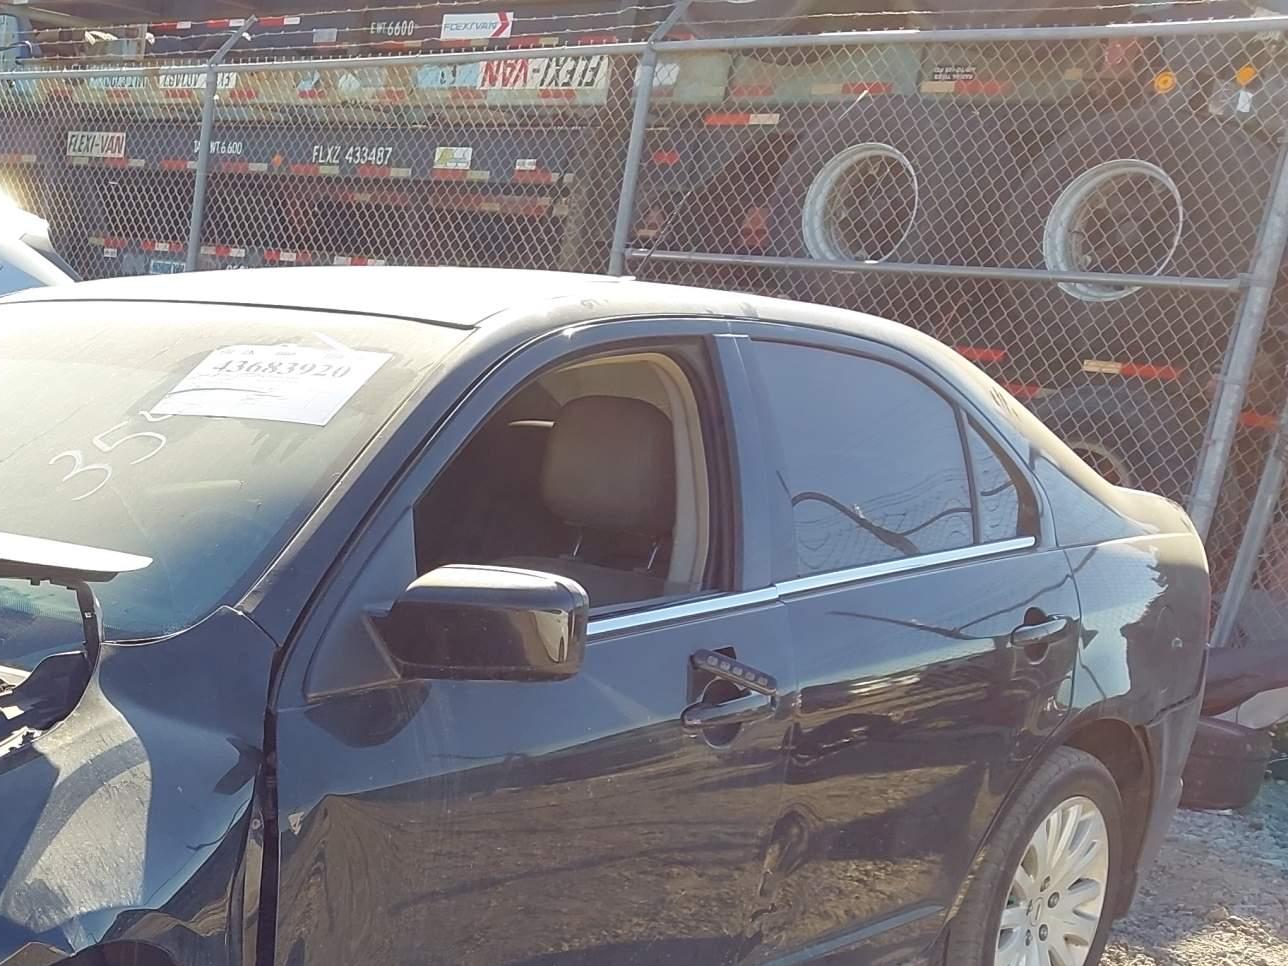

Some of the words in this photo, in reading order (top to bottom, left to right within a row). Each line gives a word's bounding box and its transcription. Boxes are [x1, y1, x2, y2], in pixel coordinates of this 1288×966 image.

[387, 20, 414, 36] 6600
[69, 134, 124, 153] FLEXI-VAN
[313, 145, 341, 164] FLXZ
[345, 147, 392, 165] 433487
[213, 359, 352, 379] 43683920
